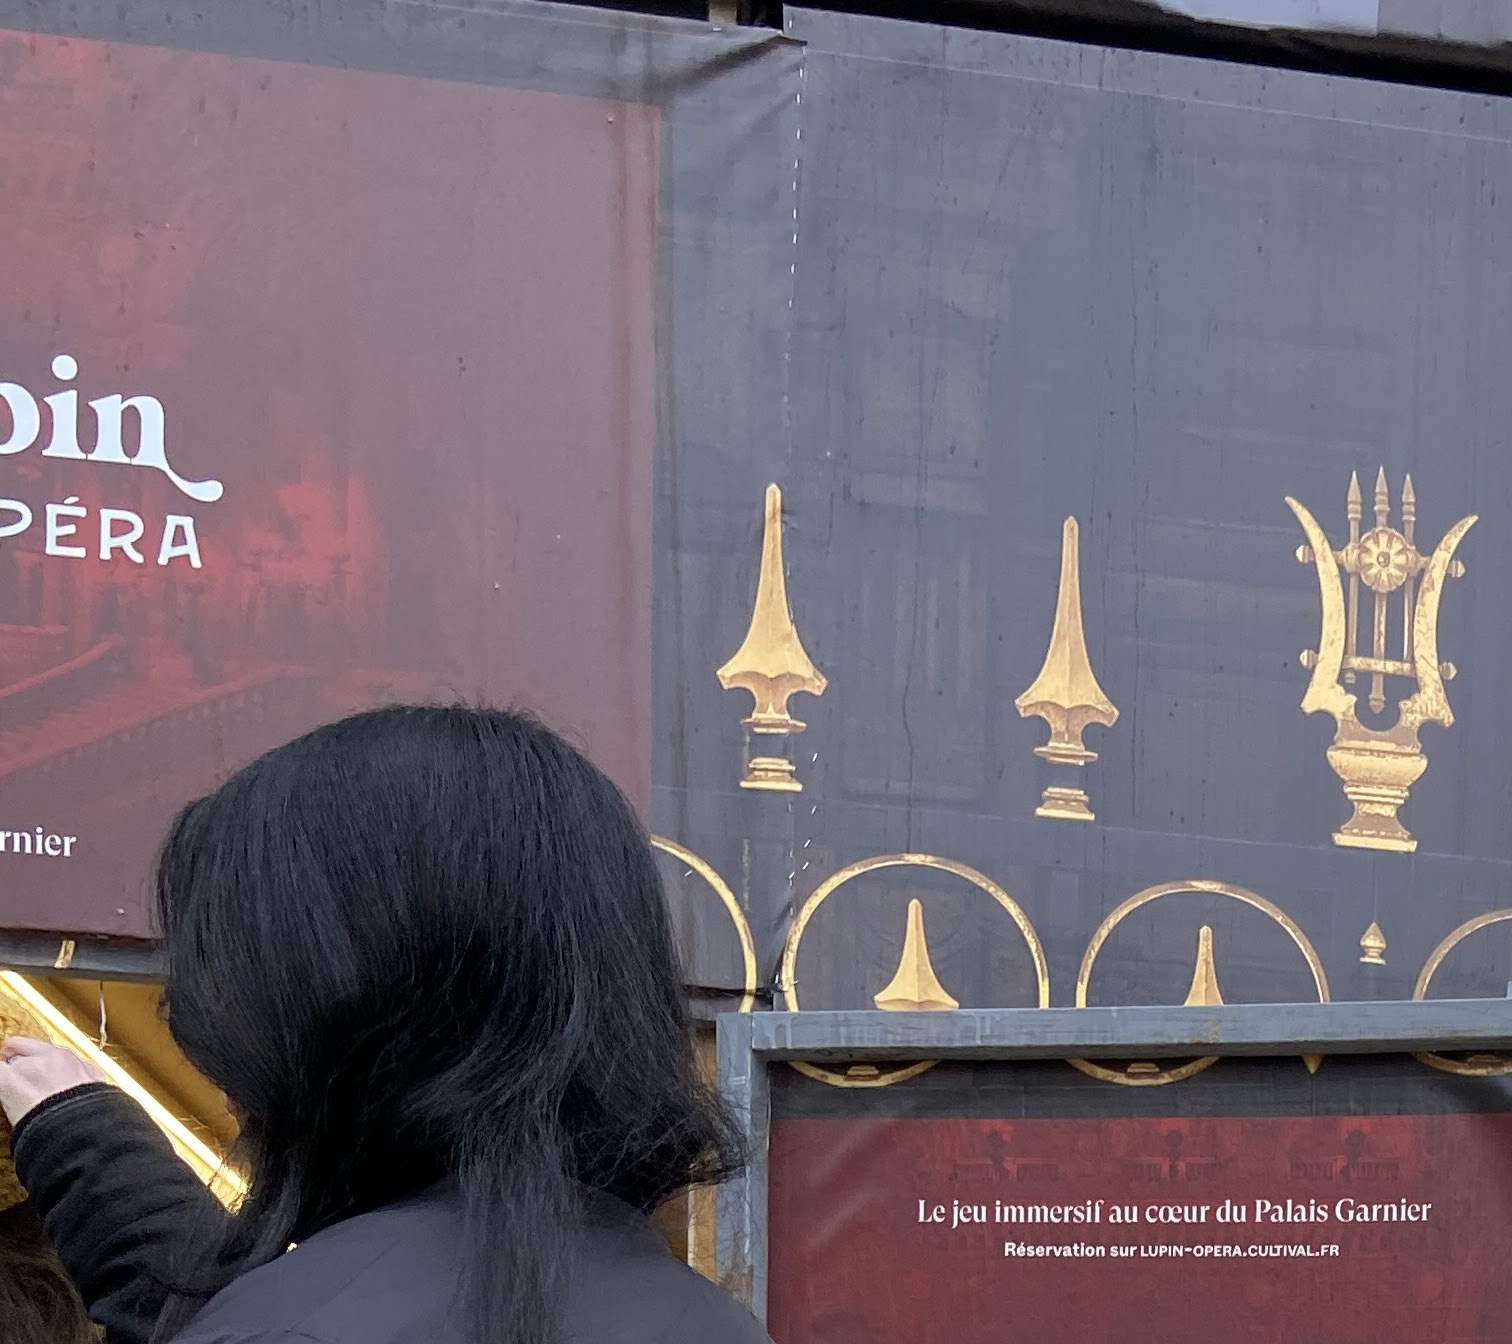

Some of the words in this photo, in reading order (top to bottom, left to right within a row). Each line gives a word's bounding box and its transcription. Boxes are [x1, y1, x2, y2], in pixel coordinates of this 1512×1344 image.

[0, 496, 202, 569] PÉRA
[0, 826, 77, 857] rnier
[918, 1199, 945, 1223] Le
[951, 1199, 987, 1229] jeu
[995, 1199, 1104, 1224] immersif
[1108, 1205, 1139, 1224] au
[1145, 1205, 1211, 1224] cœur
[1216, 1199, 1247, 1223] du
[1254, 1198, 1329, 1223] Palais
[1334, 1197, 1432, 1223] Garnier
[1004, 1240, 1106, 1257] Réservation
[1109, 1245, 1138, 1258] sur
[1140, 1244, 1340, 1258] LUPIN-OPERA.CULTIVAL.FR
